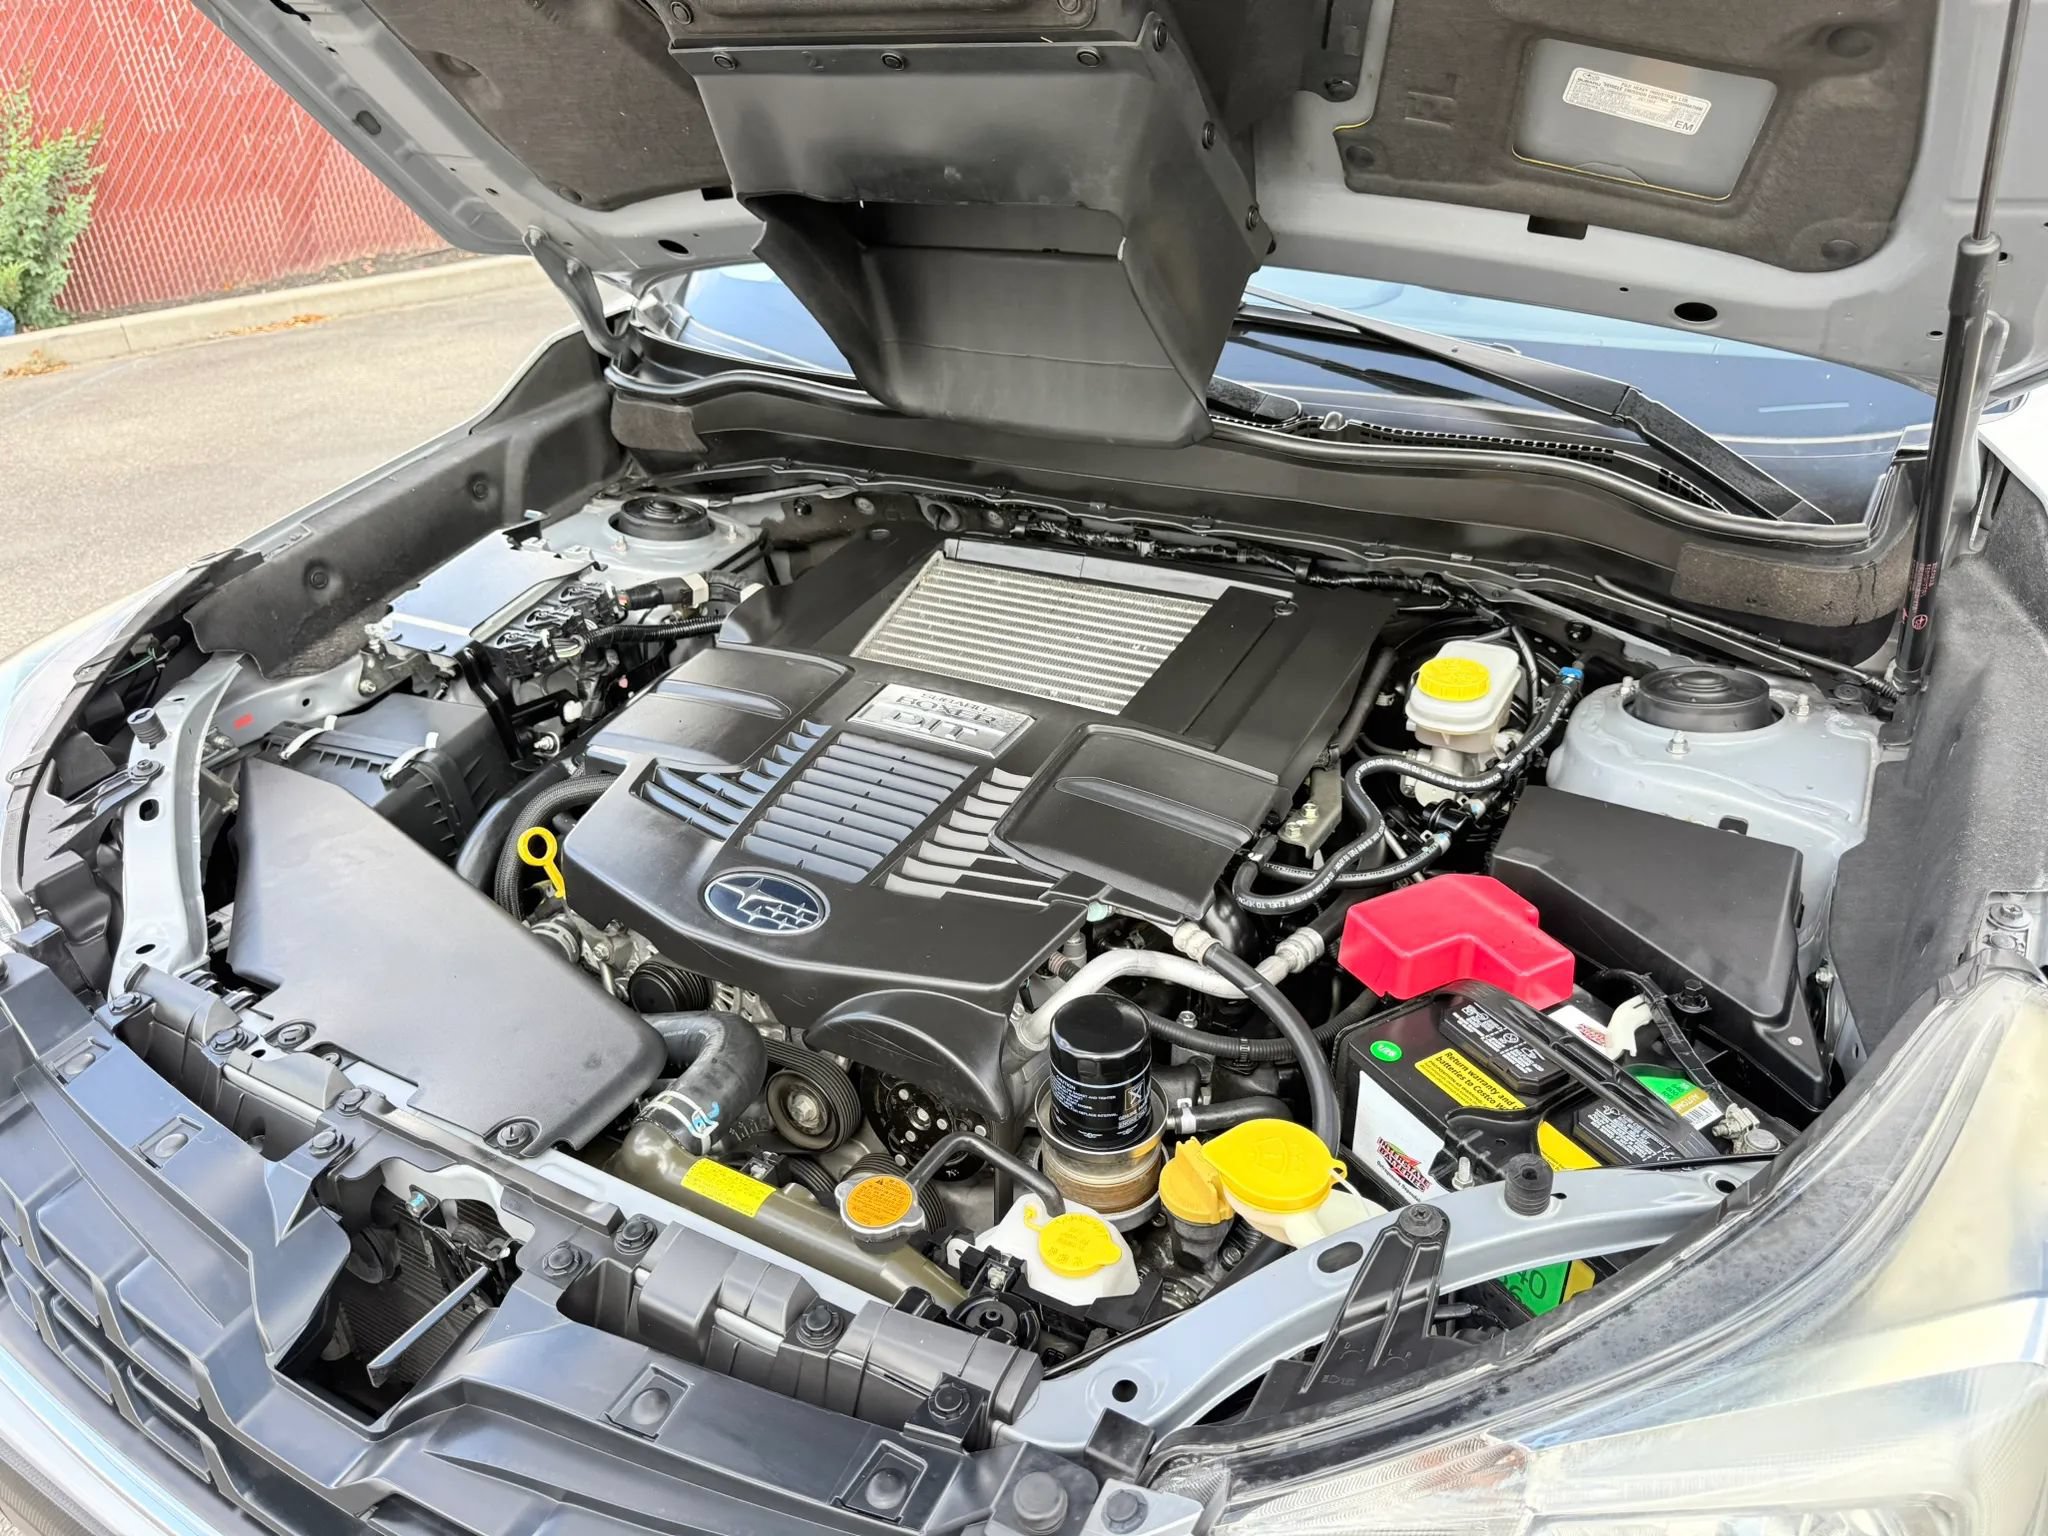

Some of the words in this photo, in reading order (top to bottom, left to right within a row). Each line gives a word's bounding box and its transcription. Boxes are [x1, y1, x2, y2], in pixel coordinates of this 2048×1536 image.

[1673, 119, 1694, 131] EM
[893, 712, 979, 739] DIT
[896, 696, 996, 724] BOXER
[1056, 1075, 1075, 1090] CAUTION
[1435, 1056, 1466, 1081] batteries
[1464, 1078, 1473, 1086] to
[1472, 1084, 1496, 1104] Costco
[1444, 1051, 1469, 1071] Return
[1467, 1069, 1499, 1096] warranty
[1497, 1092, 1515, 1107] and
[1376, 1136, 1432, 1188] INTERSTATE
[1377, 1146, 1427, 1192] BATTERIES
